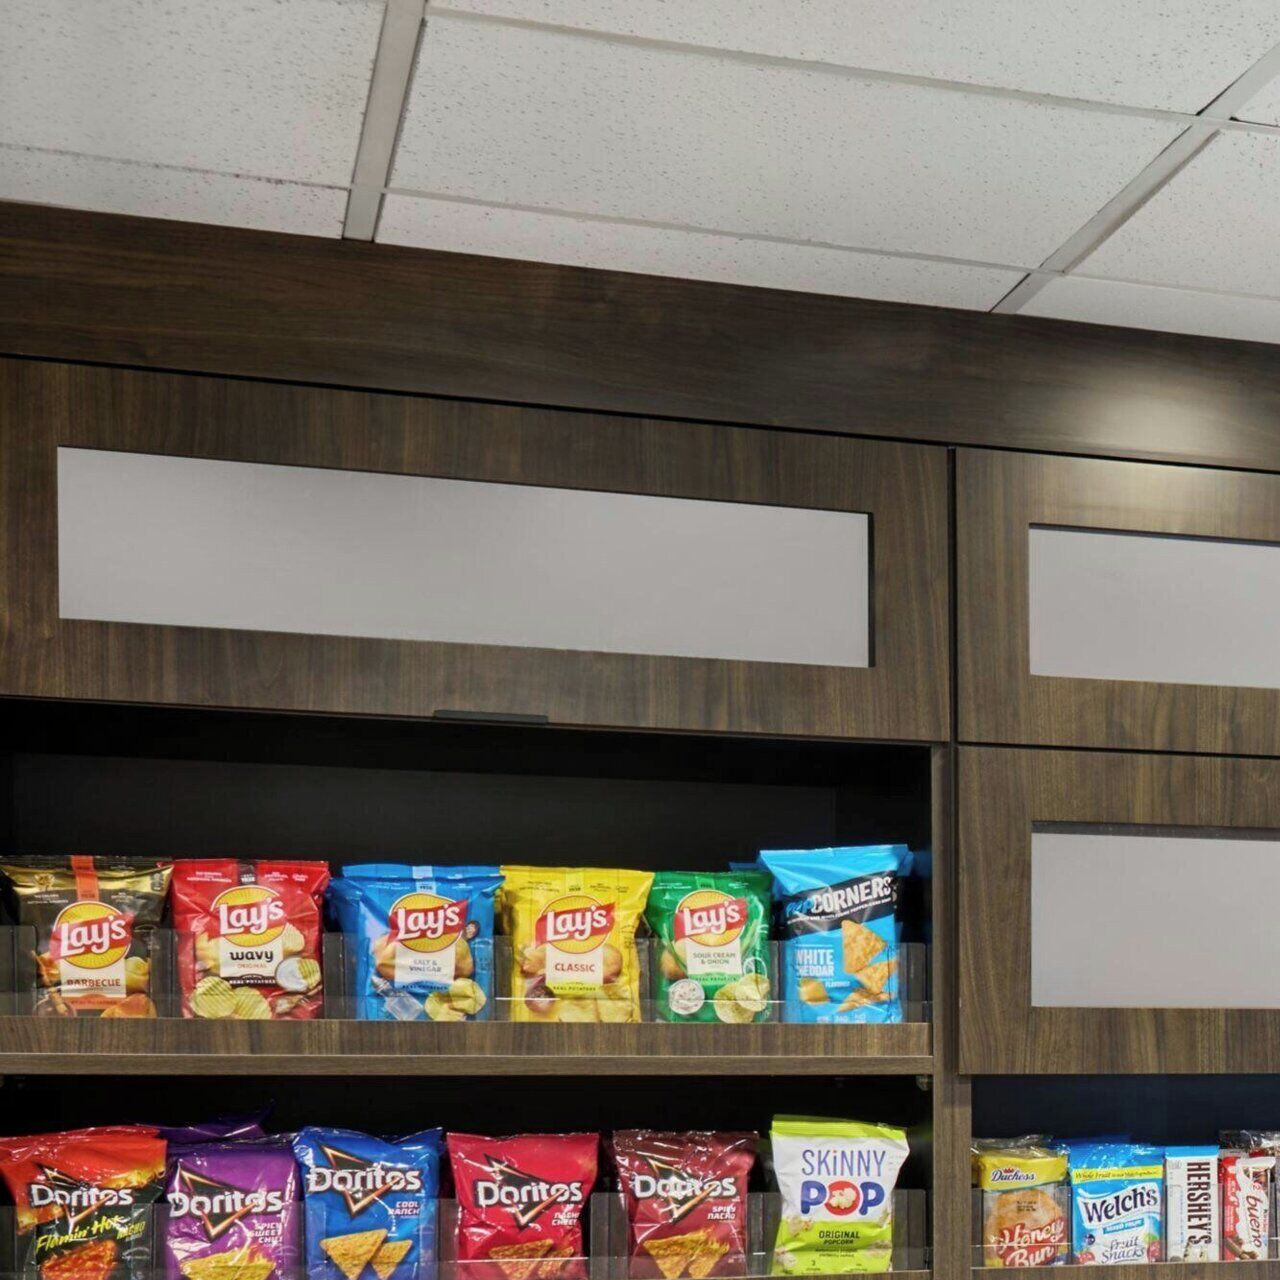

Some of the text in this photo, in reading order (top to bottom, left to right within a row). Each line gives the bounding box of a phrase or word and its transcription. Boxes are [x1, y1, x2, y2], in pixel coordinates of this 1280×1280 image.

[219, 898, 286, 935] Lay's
[396, 902, 461, 938] Lay's
[545, 904, 610, 942] Lay's
[682, 900, 742, 935] Lay's
[60, 914, 128, 957] Lay's
[229, 949, 274, 964] wavy
[554, 962, 595, 973] CLASSIC
[66, 977, 121, 989] BARBECUE
[307, 1165, 421, 1193] Doritos
[990, 1168, 1038, 1184] Duchess
[30, 1183, 134, 1207] Doritos
[169, 1188, 283, 1218] Doritos
[396, 1201, 419, 1209] COOL
[477, 1179, 583, 1208] Doritos
[800, 1181, 886, 1217] POP
[1083, 1183, 1159, 1223] Welch's
[1187, 1161, 1212, 1247] HERSHEY'S
[819, 1230, 860, 1239] ORIGINAL
[999, 1216, 1065, 1250] Honey
[1245, 1194, 1263, 1250] bueno
[1101, 1246, 1146, 1265] Snacks
[1109, 1234, 1140, 1250] Fruit
